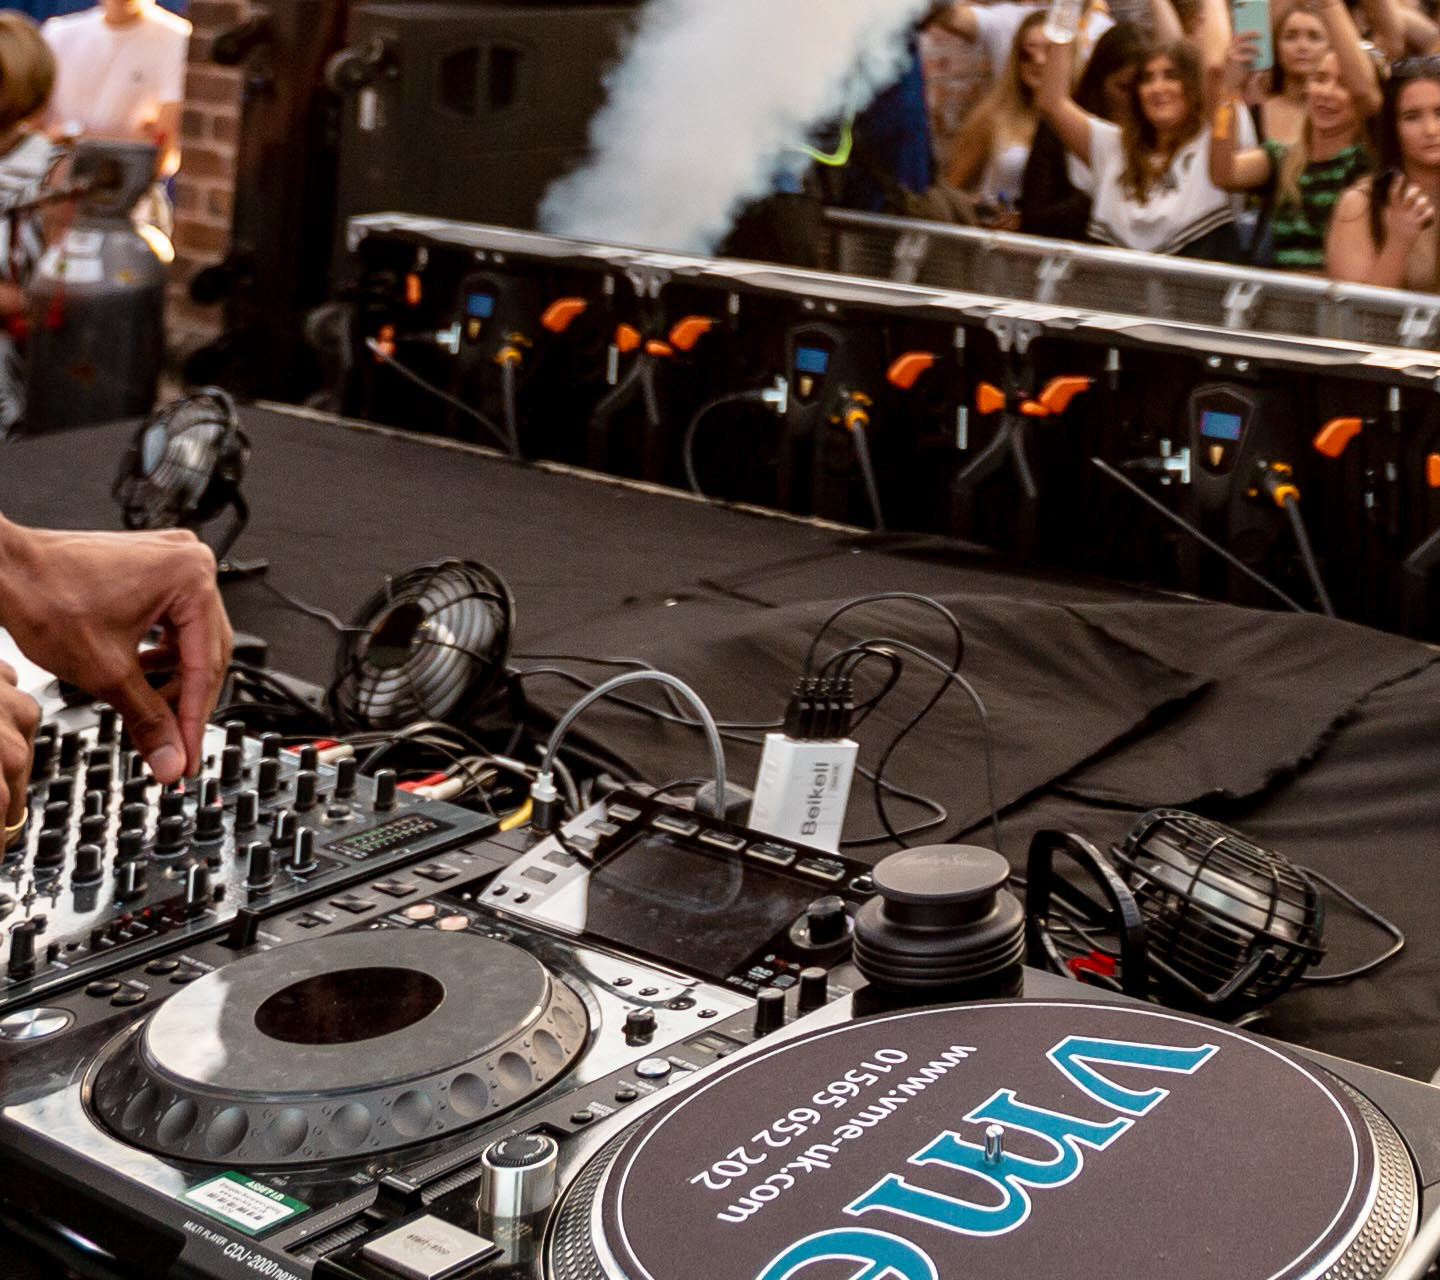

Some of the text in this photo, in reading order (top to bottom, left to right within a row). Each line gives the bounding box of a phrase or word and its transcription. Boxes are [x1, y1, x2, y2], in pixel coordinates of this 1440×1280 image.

[689, 1048, 909, 1190] 01565 652 202
[716, 1044, 978, 1223] www.vme-uk.com
